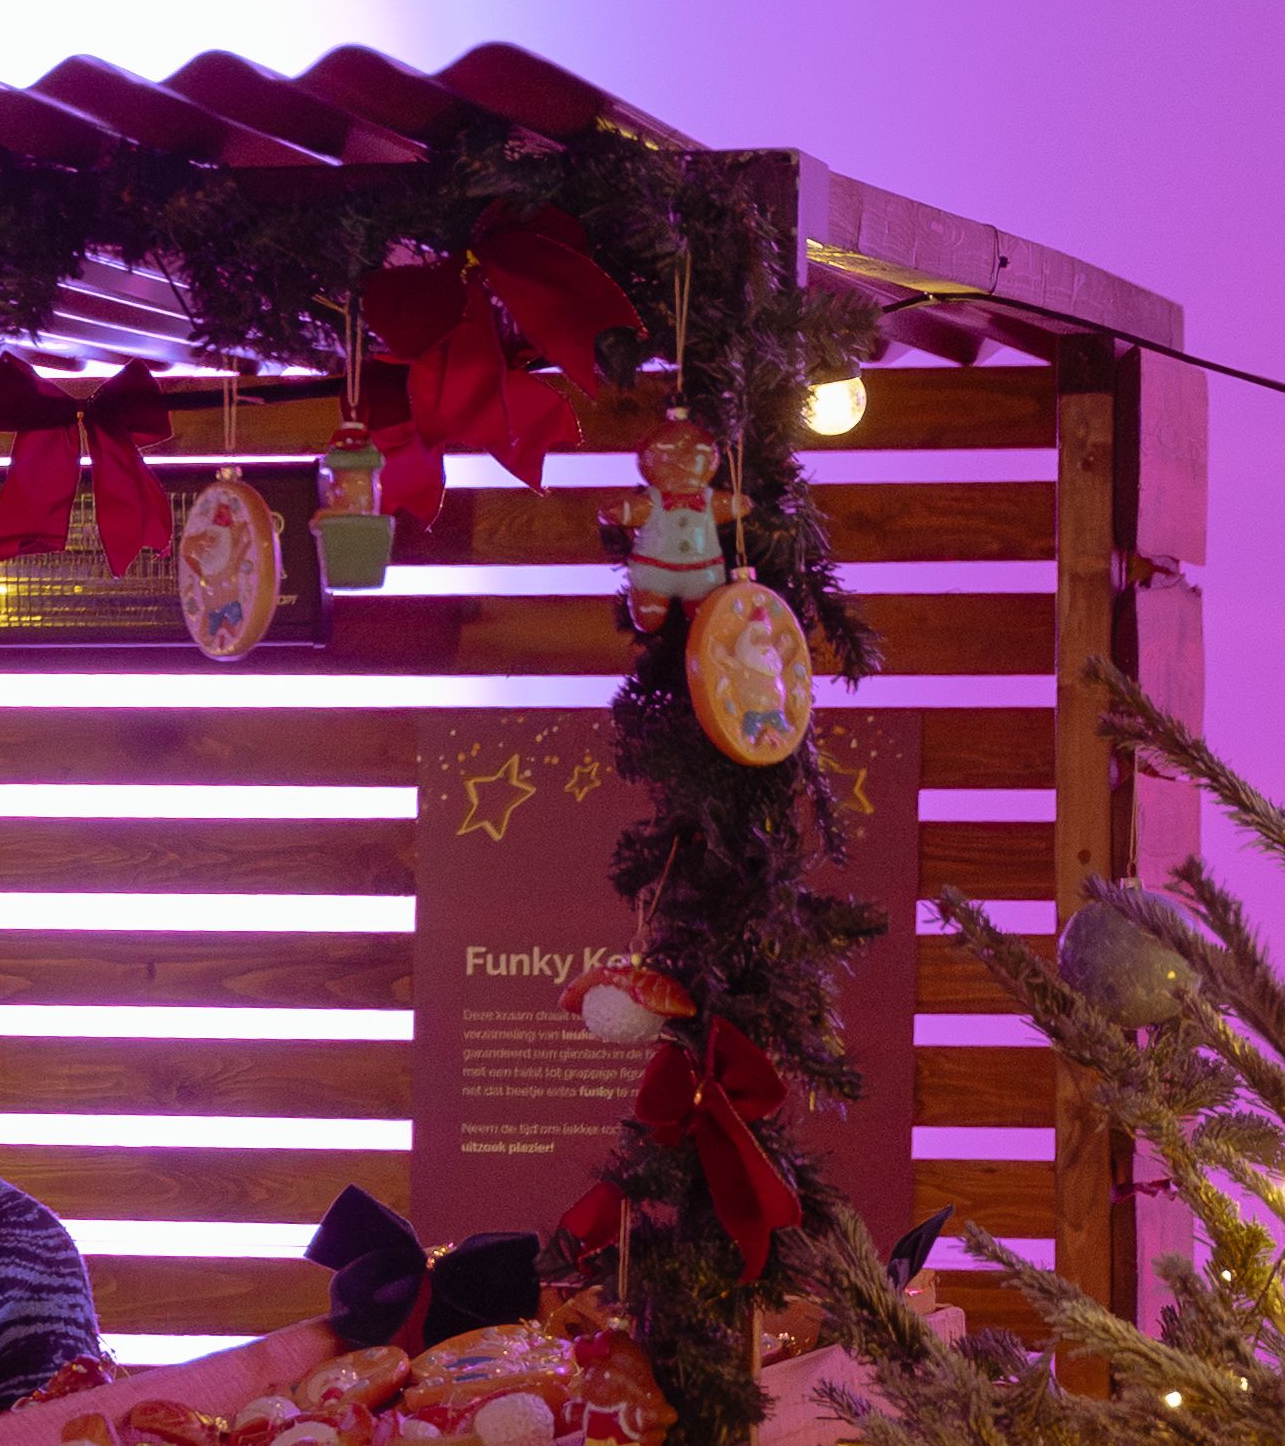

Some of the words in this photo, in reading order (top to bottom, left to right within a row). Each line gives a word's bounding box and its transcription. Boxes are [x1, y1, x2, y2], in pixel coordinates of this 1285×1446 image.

[465, 945, 574, 984] Funky
[583, 946, 626, 974] Ke
[463, 1028, 535, 1042] verzameling
[463, 1047, 531, 1061] garandeerd
[463, 1066, 486, 1077] met
[488, 1068, 512, 1078] een
[545, 1066, 561, 1077] tot
[564, 1066, 618, 1081] grappige
[620, 1066, 645, 1081] figu
[462, 1085, 482, 1096] net
[484, 1085, 504, 1096] dat
[506, 1085, 544, 1099] beetje
[546, 1086, 577, 1097] extra
[579, 1085, 615, 1099] funky
[462, 1122, 498, 1133] Neem
[563, 1123, 599, 1134] lekker
